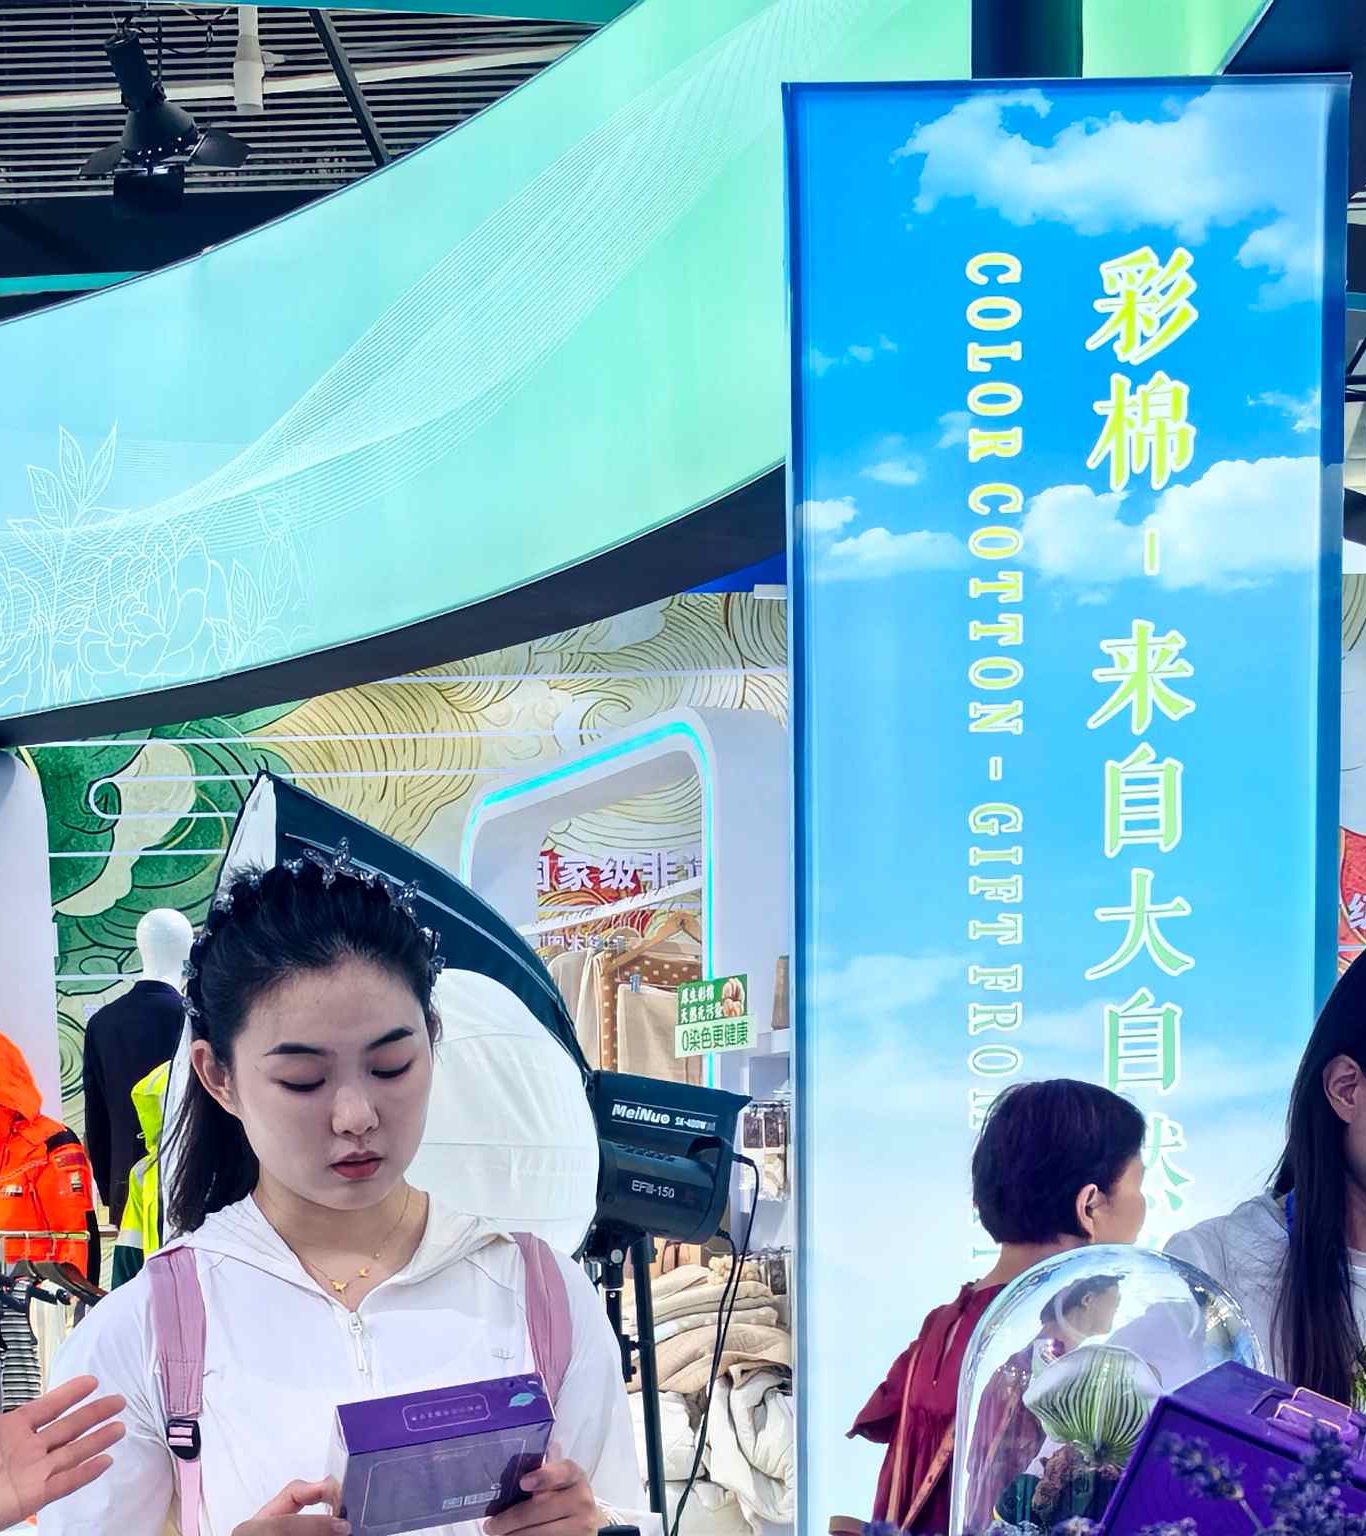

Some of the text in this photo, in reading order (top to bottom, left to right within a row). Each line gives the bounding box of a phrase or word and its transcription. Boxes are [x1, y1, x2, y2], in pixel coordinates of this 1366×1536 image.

[966, 252, 1024, 463] COLOR
[967, 483, 1024, 736] COTTON
[968, 803, 1024, 945] GIFT
[611, 1103, 671, 1125] MeiNuo
